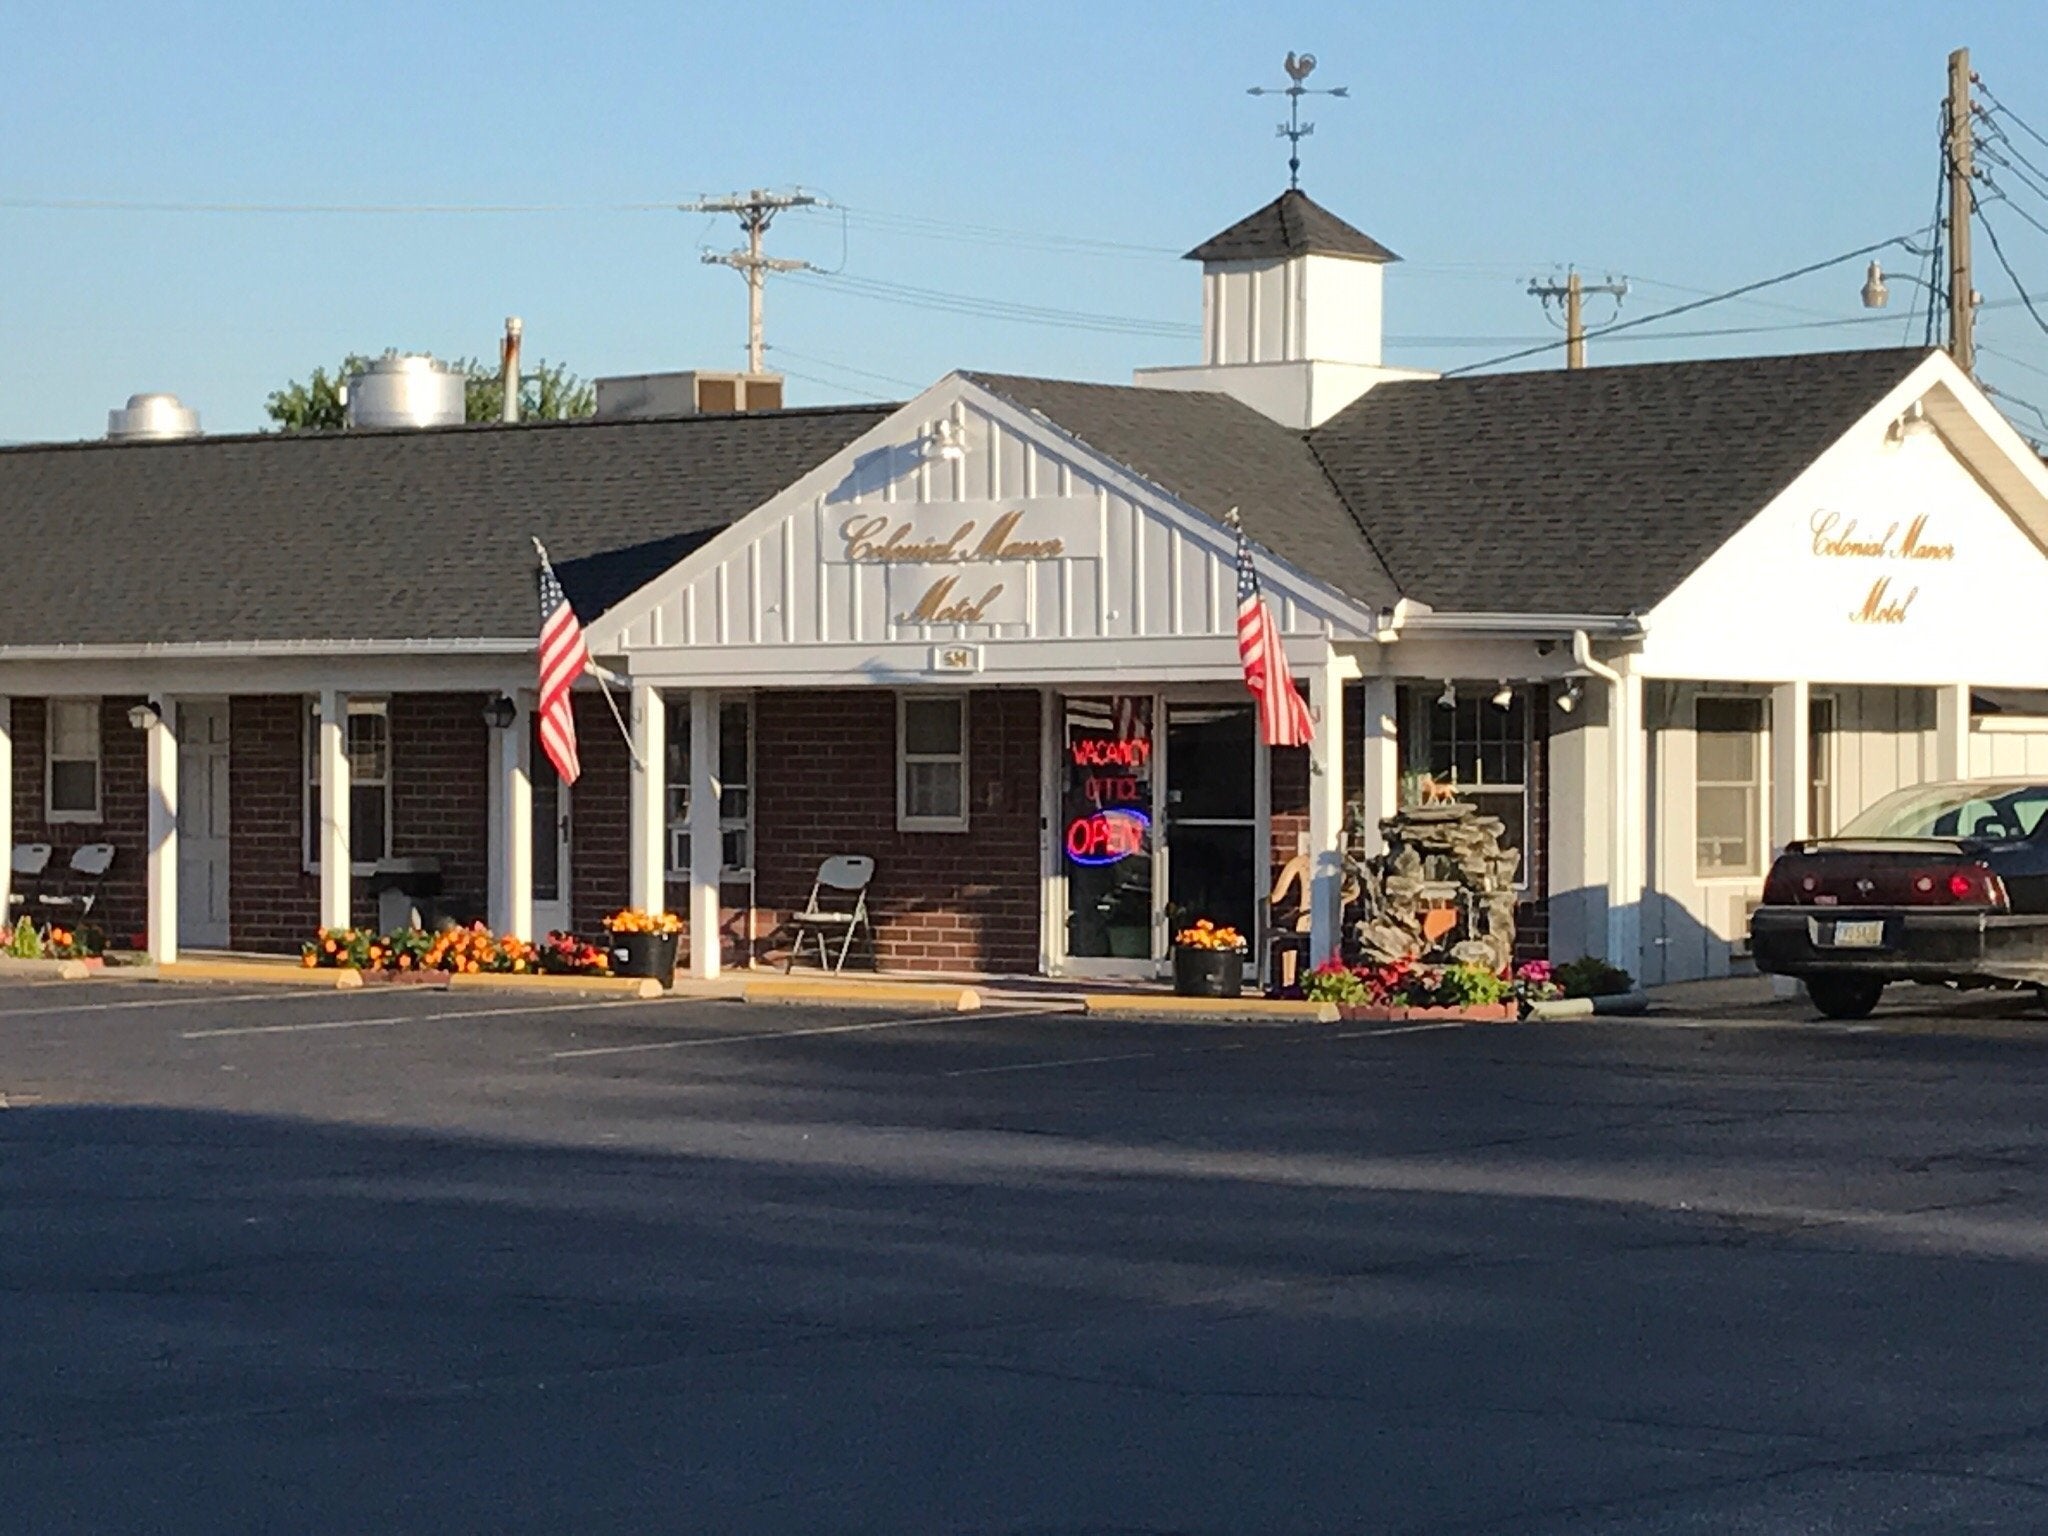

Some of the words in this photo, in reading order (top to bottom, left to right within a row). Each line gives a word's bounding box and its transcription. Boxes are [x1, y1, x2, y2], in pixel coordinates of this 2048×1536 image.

[839, 513, 976, 560] Colonial
[960, 510, 1064, 559] Manor
[1810, 508, 1899, 557] Colonial
[1890, 512, 1954, 560] Manor
[895, 574, 1004, 623] Motel
[1849, 575, 1918, 623] Motel
[1072, 739, 1150, 767] VACANCY
[1085, 776, 1141, 799] OFFICE
[1068, 818, 1143, 855] OPEN
